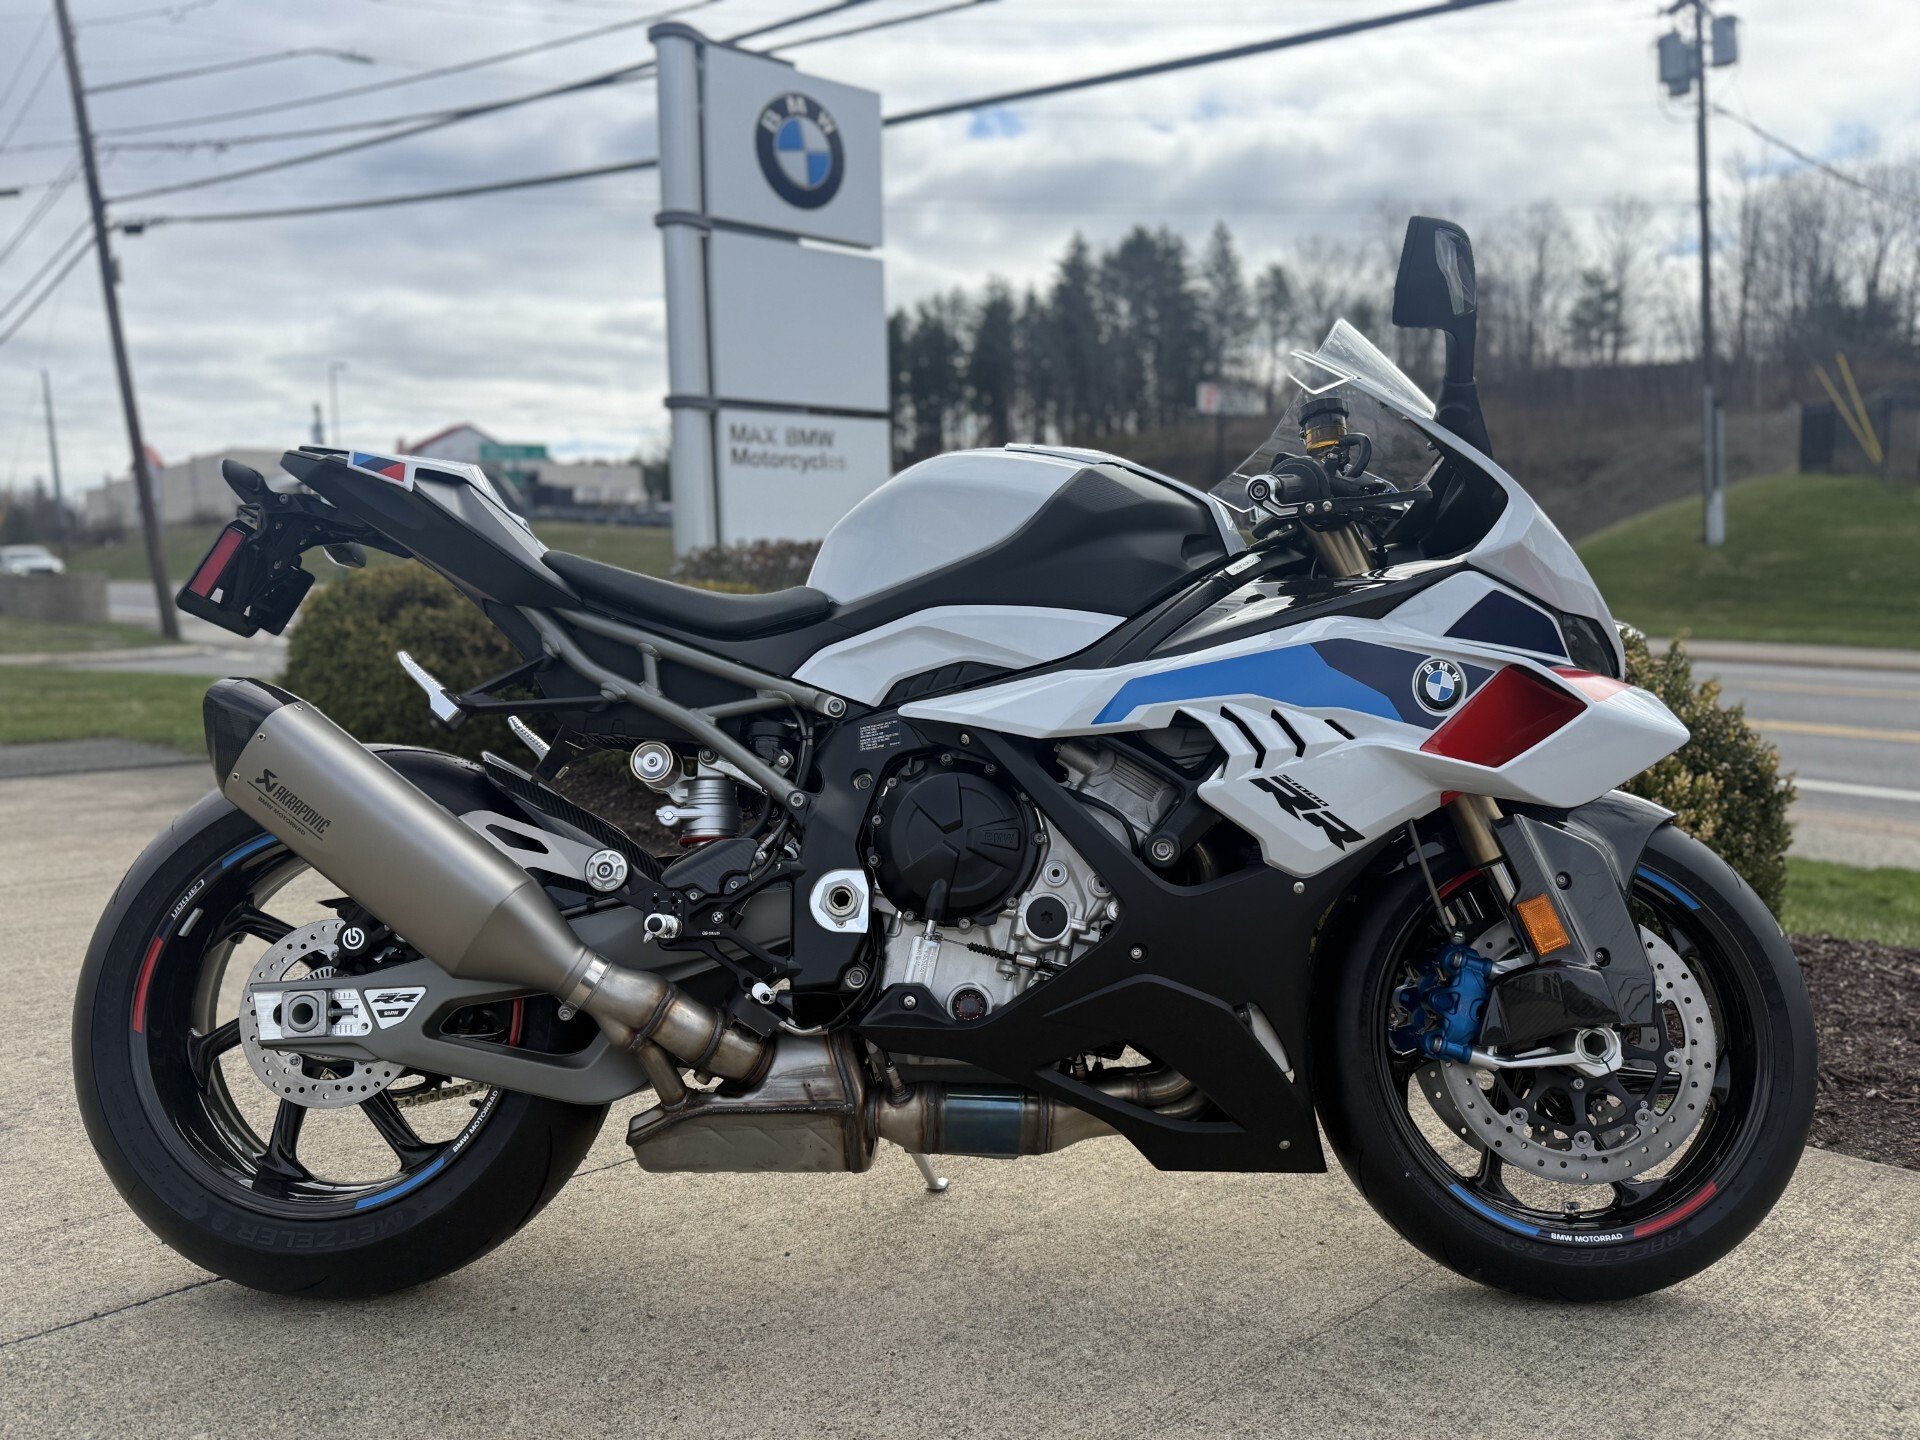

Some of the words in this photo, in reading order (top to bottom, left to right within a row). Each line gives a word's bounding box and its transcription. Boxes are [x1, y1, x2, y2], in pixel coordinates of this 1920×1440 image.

[729, 424, 777, 444] MAX
[785, 426, 836, 447] BMW
[730, 448, 848, 473] Motorcycles
[257, 796, 274, 811] BMW
[273, 808, 306, 836] MOTORRAD
[170, 878, 205, 921] Carbon
[452, 1133, 470, 1153] BMW
[468, 1090, 499, 1134] MOTORRAD
[235, 1211, 406, 1250] METZELER
[1550, 1232, 1573, 1242] BMW
[1574, 1232, 1624, 1243] MOTORRAD
